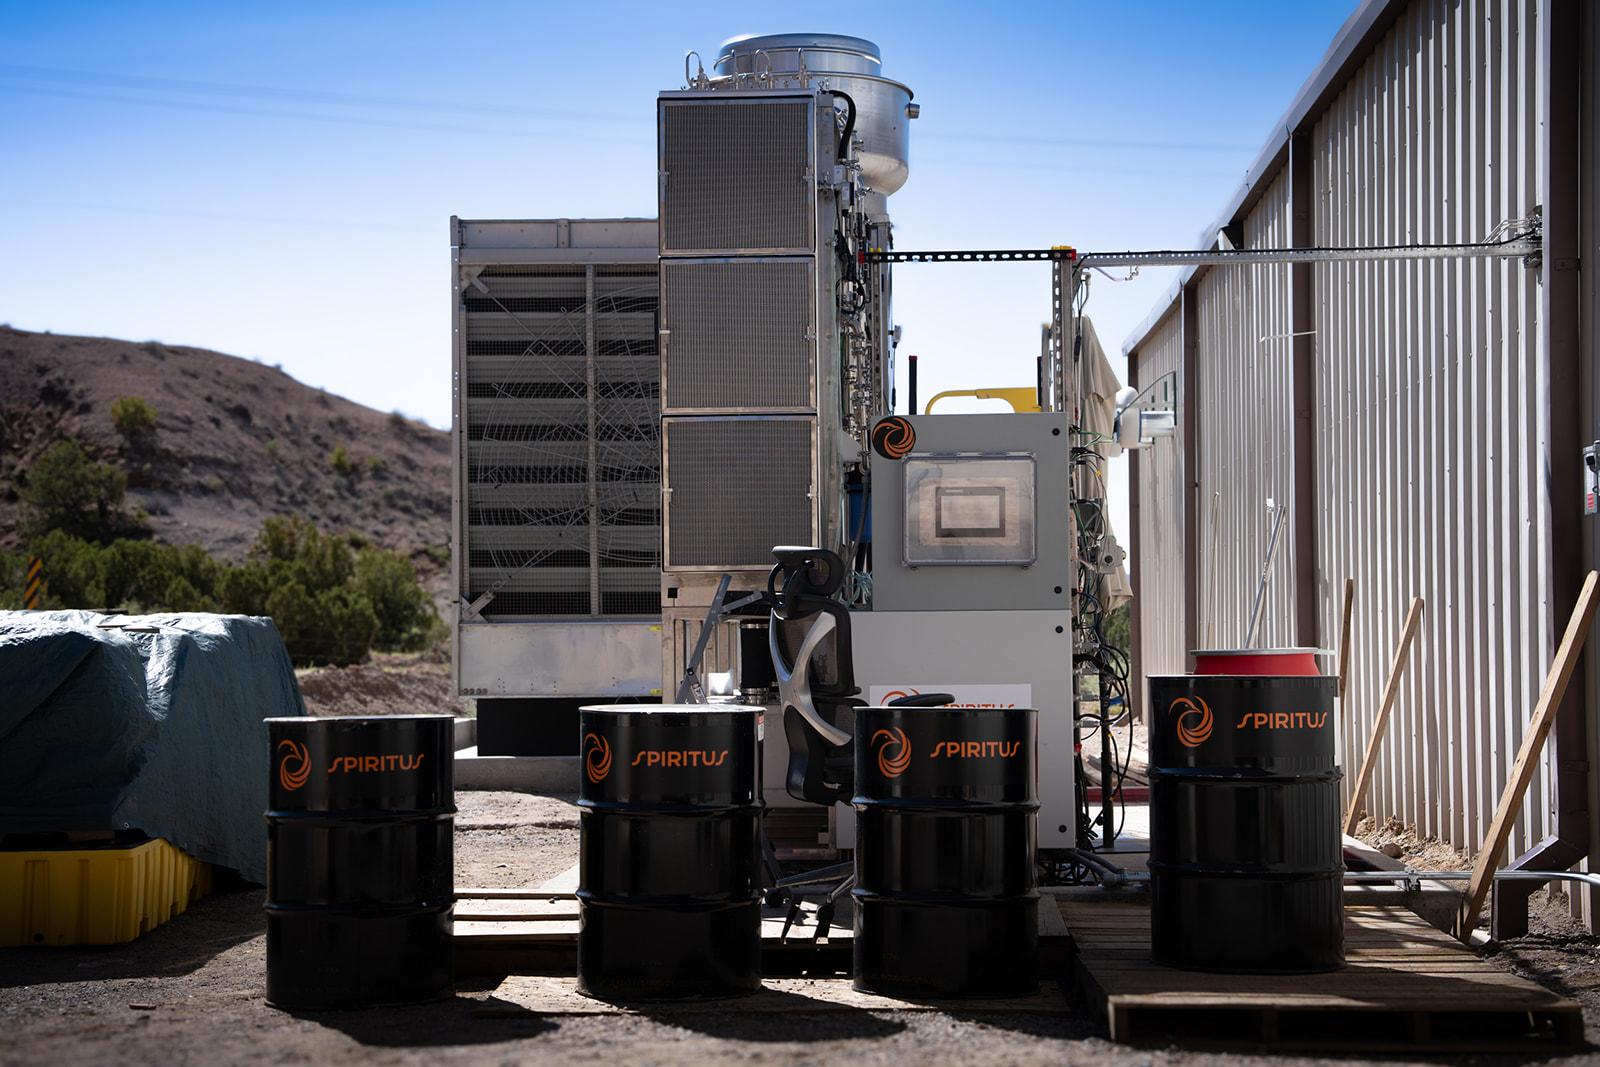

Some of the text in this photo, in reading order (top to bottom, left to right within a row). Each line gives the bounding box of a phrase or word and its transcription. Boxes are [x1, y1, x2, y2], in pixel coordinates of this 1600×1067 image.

[1236, 711, 1328, 729] SPIRITUS
[929, 740, 1021, 758] SPIRITUS
[327, 753, 425, 773] SPIRITUS
[631, 749, 729, 768] SPIRITUS
